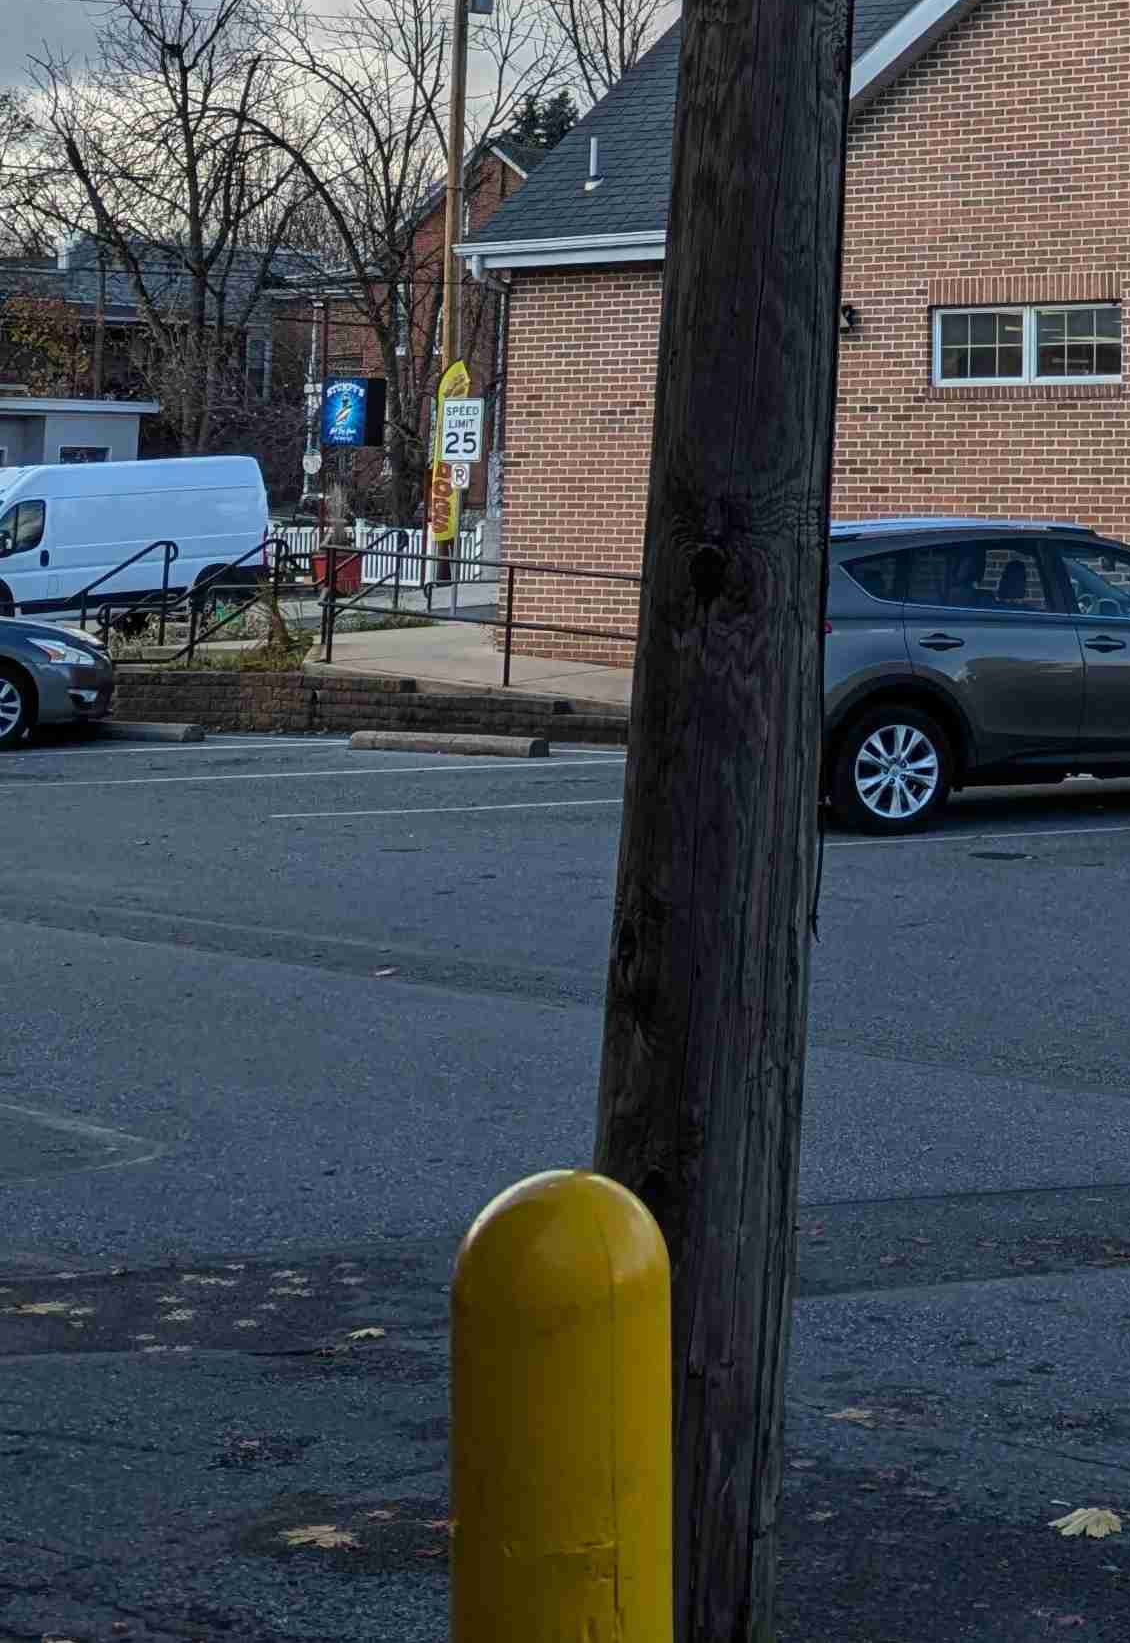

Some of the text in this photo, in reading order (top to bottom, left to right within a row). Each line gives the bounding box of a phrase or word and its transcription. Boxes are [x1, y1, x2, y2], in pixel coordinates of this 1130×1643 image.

[446, 405, 480, 417] SPEED
[448, 418, 475, 429] LIMIT
[445, 431, 477, 454] 25
